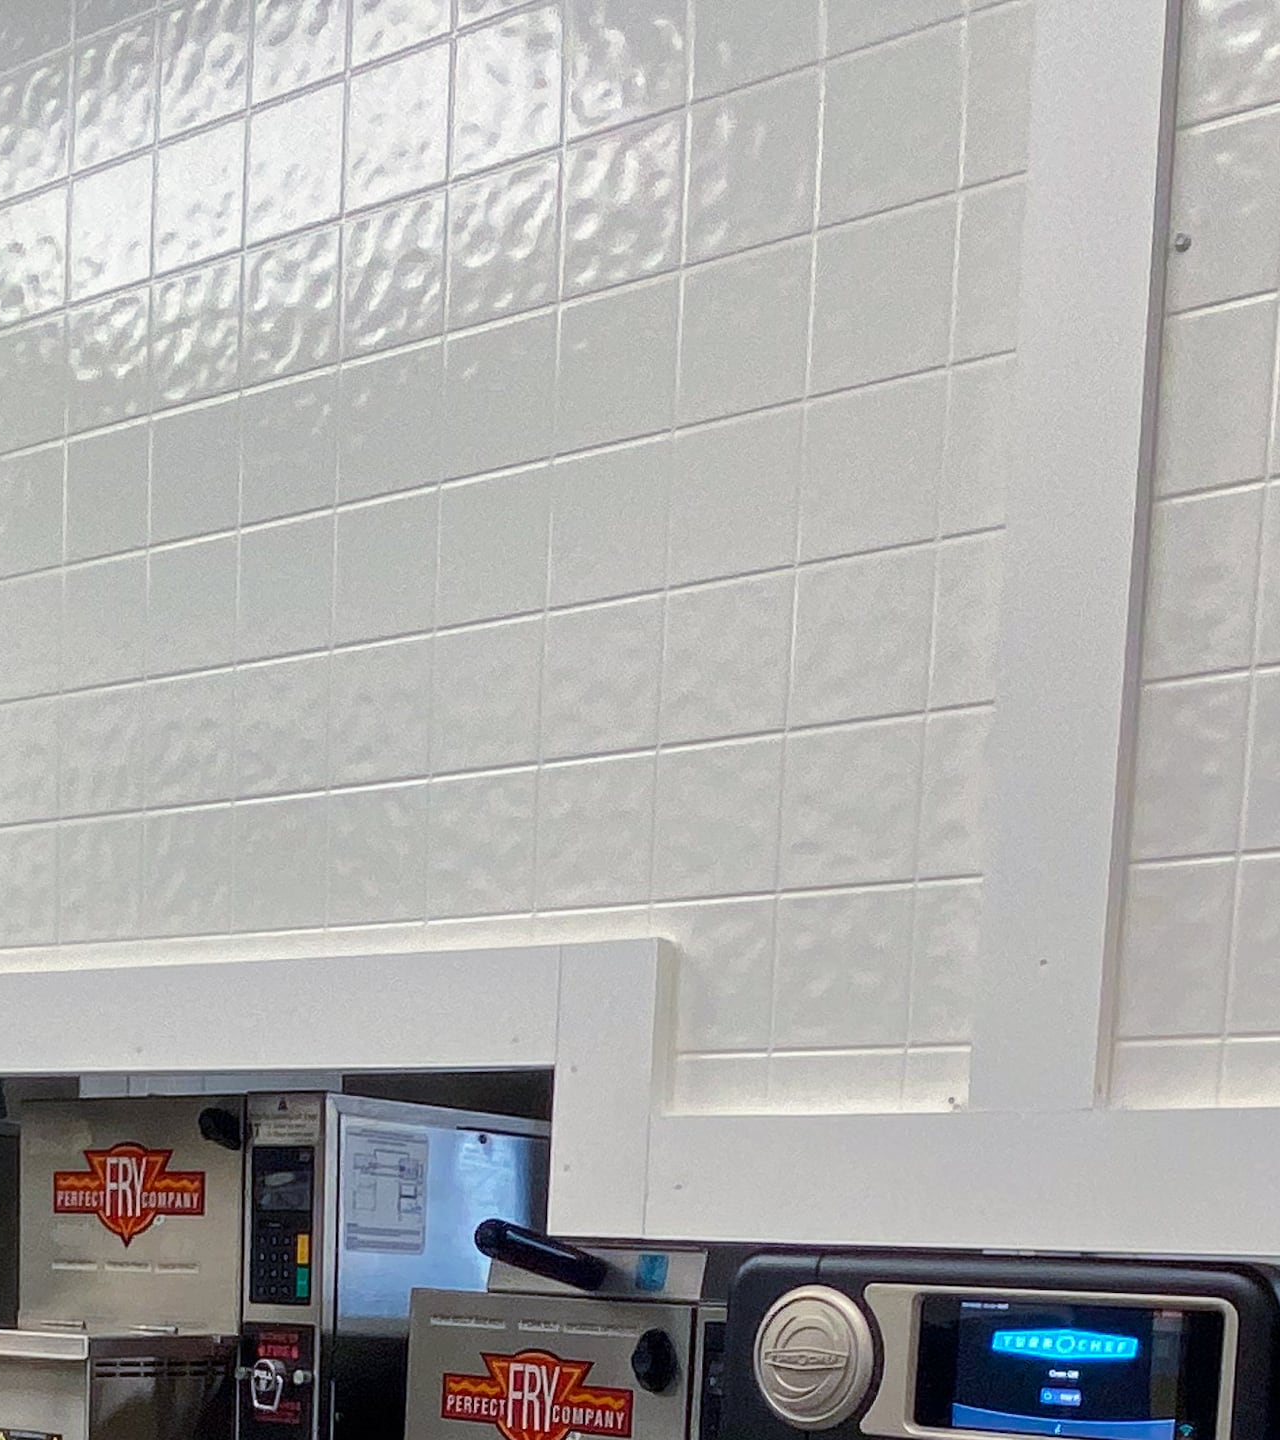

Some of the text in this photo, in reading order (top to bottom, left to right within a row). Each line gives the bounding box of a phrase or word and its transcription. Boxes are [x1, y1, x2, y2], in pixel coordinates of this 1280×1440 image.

[56, 1156, 200, 1217] PERFECT FRY COMPANY
[446, 1362, 625, 1433] PERFECT FRY COMPANY
